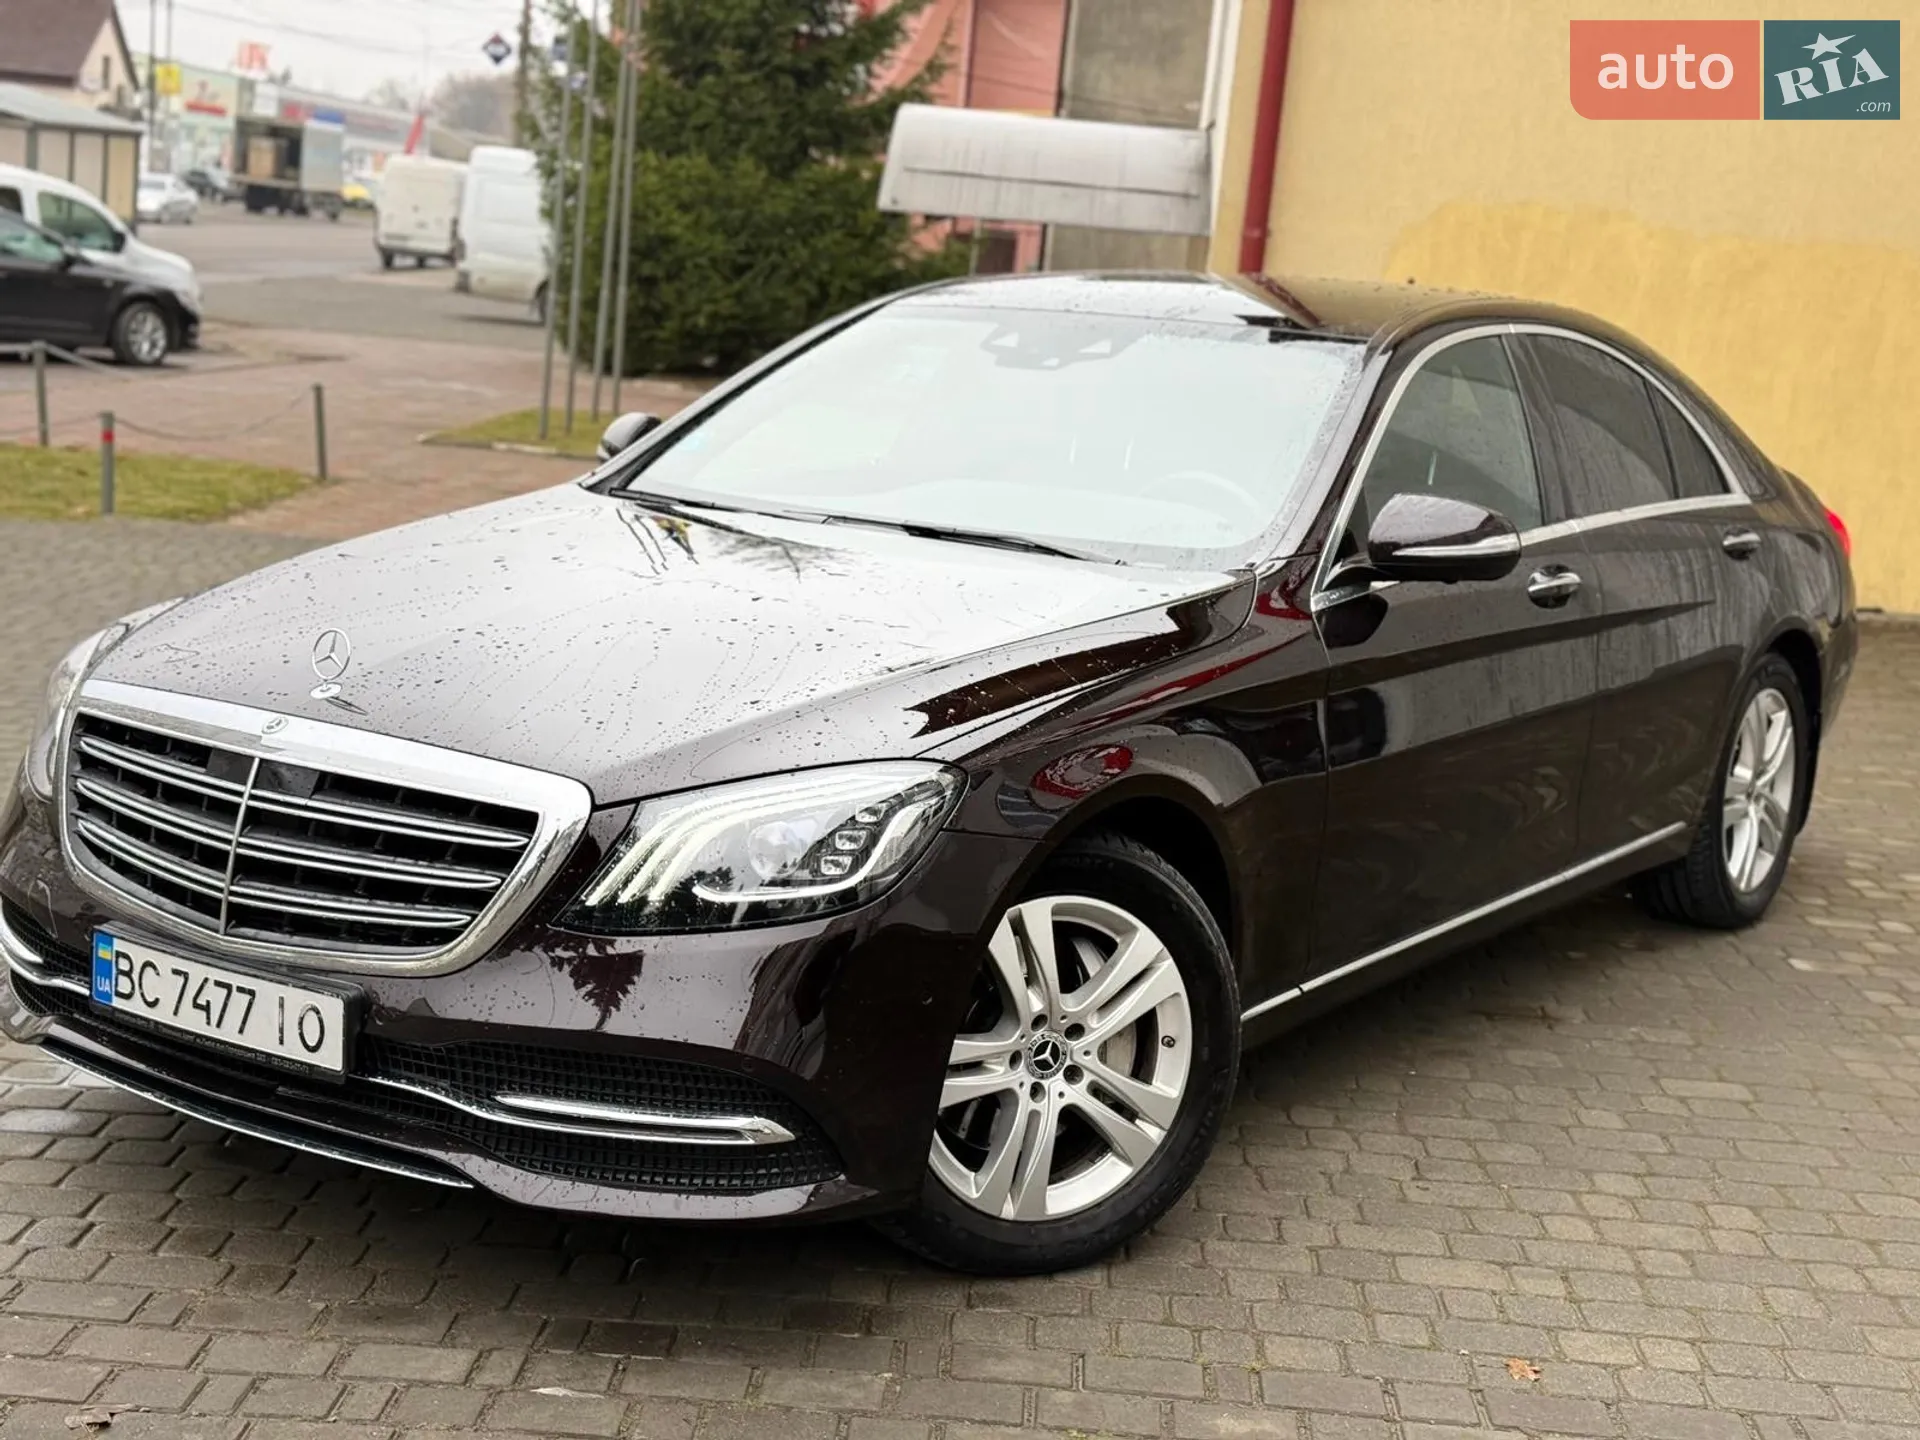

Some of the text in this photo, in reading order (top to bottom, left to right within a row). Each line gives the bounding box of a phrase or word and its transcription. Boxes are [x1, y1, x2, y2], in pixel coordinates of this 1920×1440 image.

[97, 975, 112, 993] UA
[114, 949, 161, 1009] BC
[170, 967, 256, 1036] 7477
[277, 995, 325, 1053] IO
